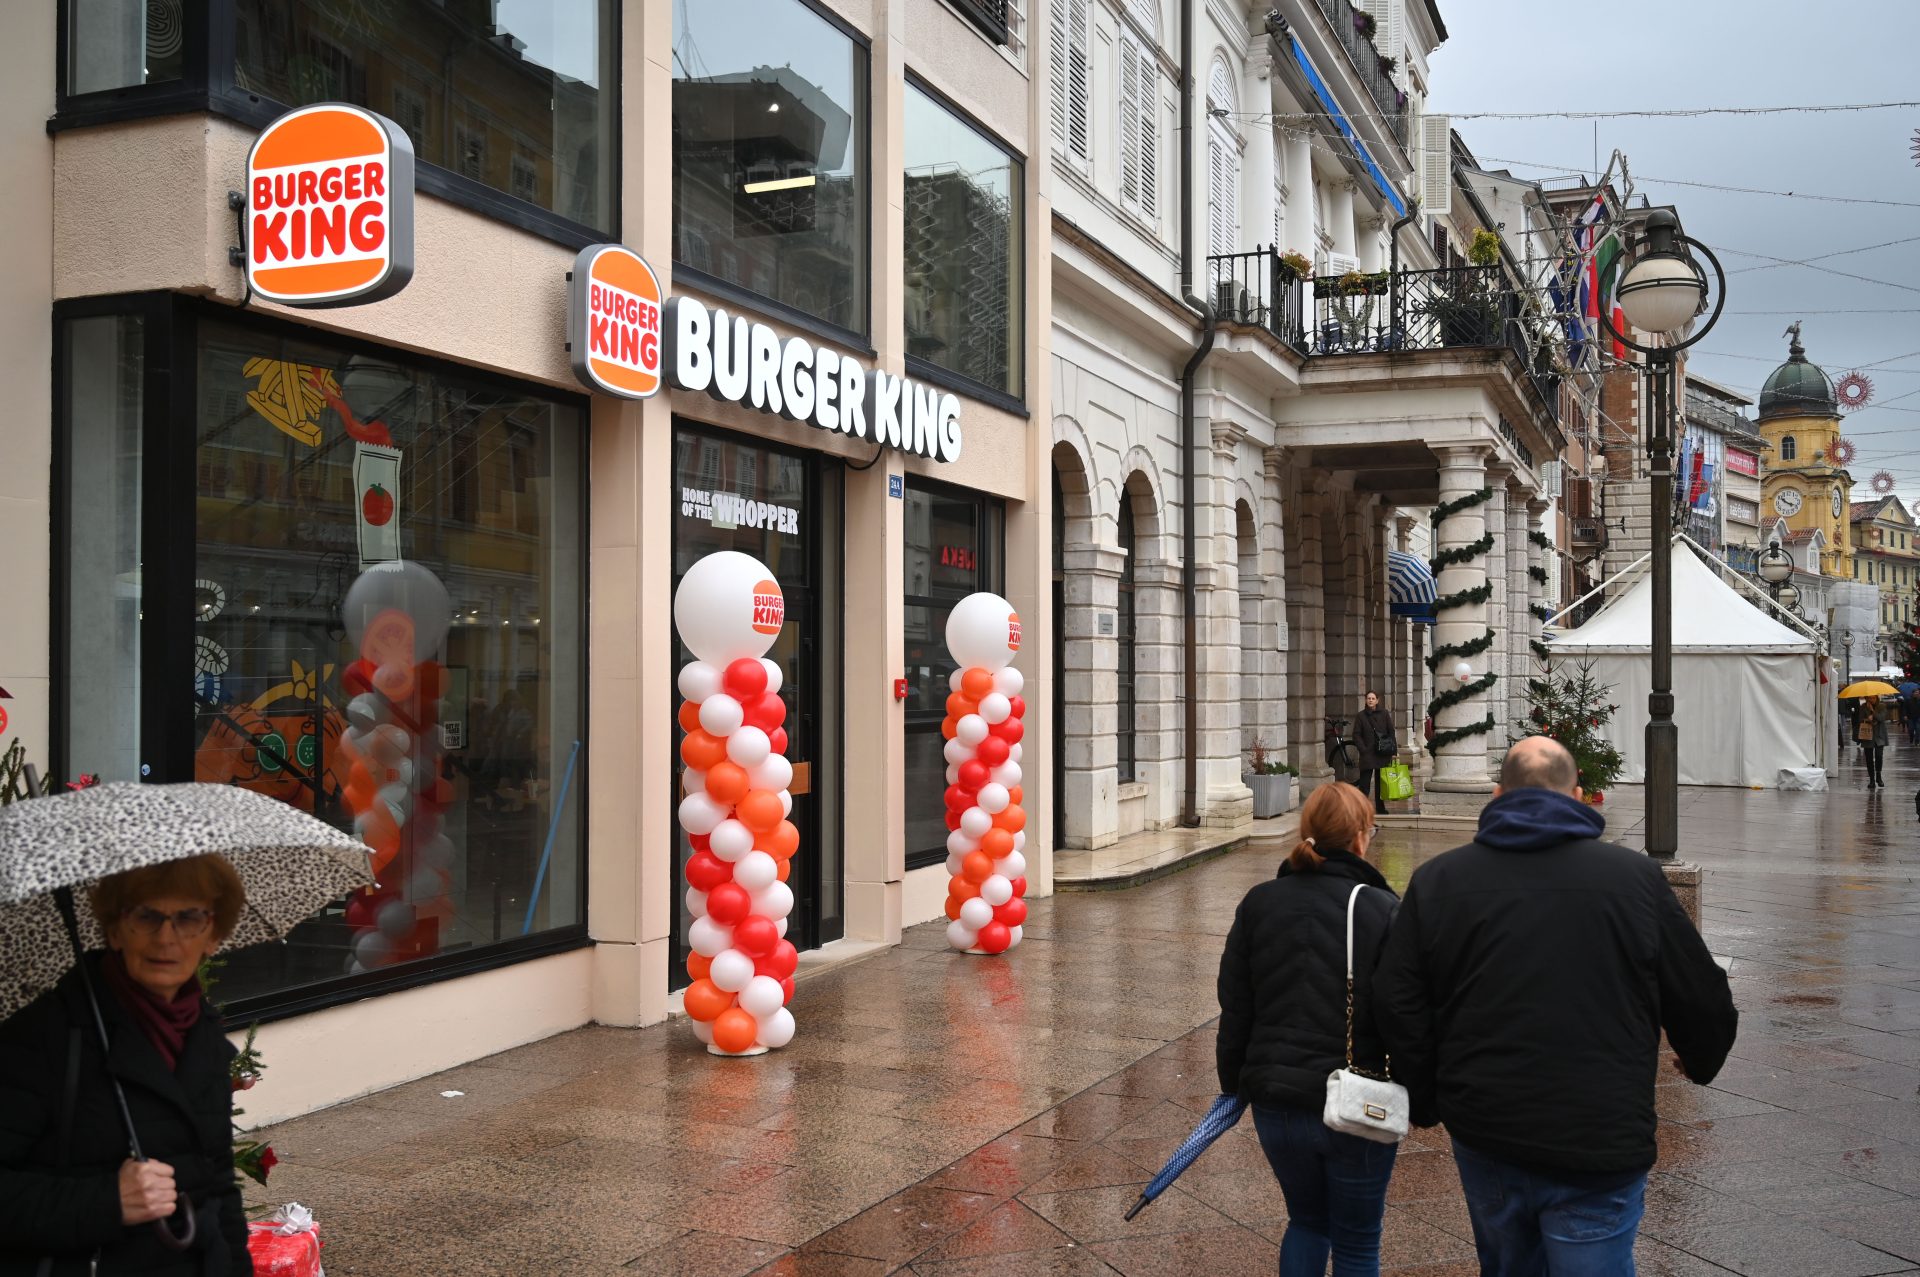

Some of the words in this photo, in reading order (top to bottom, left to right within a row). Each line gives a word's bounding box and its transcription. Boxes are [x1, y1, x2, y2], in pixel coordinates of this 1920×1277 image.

[253, 162, 385, 211] BURGER
[253, 200, 385, 264] KING
[590, 284, 659, 333] BURGER
[590, 314, 659, 370] KING
[677, 296, 866, 438] BURGER
[874, 369, 962, 463] KING
[682, 487, 710, 505] HOME
[682, 502, 694, 517] OF
[695, 504, 713, 520] THE
[711, 493, 799, 535] WHOPPER
[753, 607, 783, 626] KING
[1009, 631, 1021, 644] KIN
